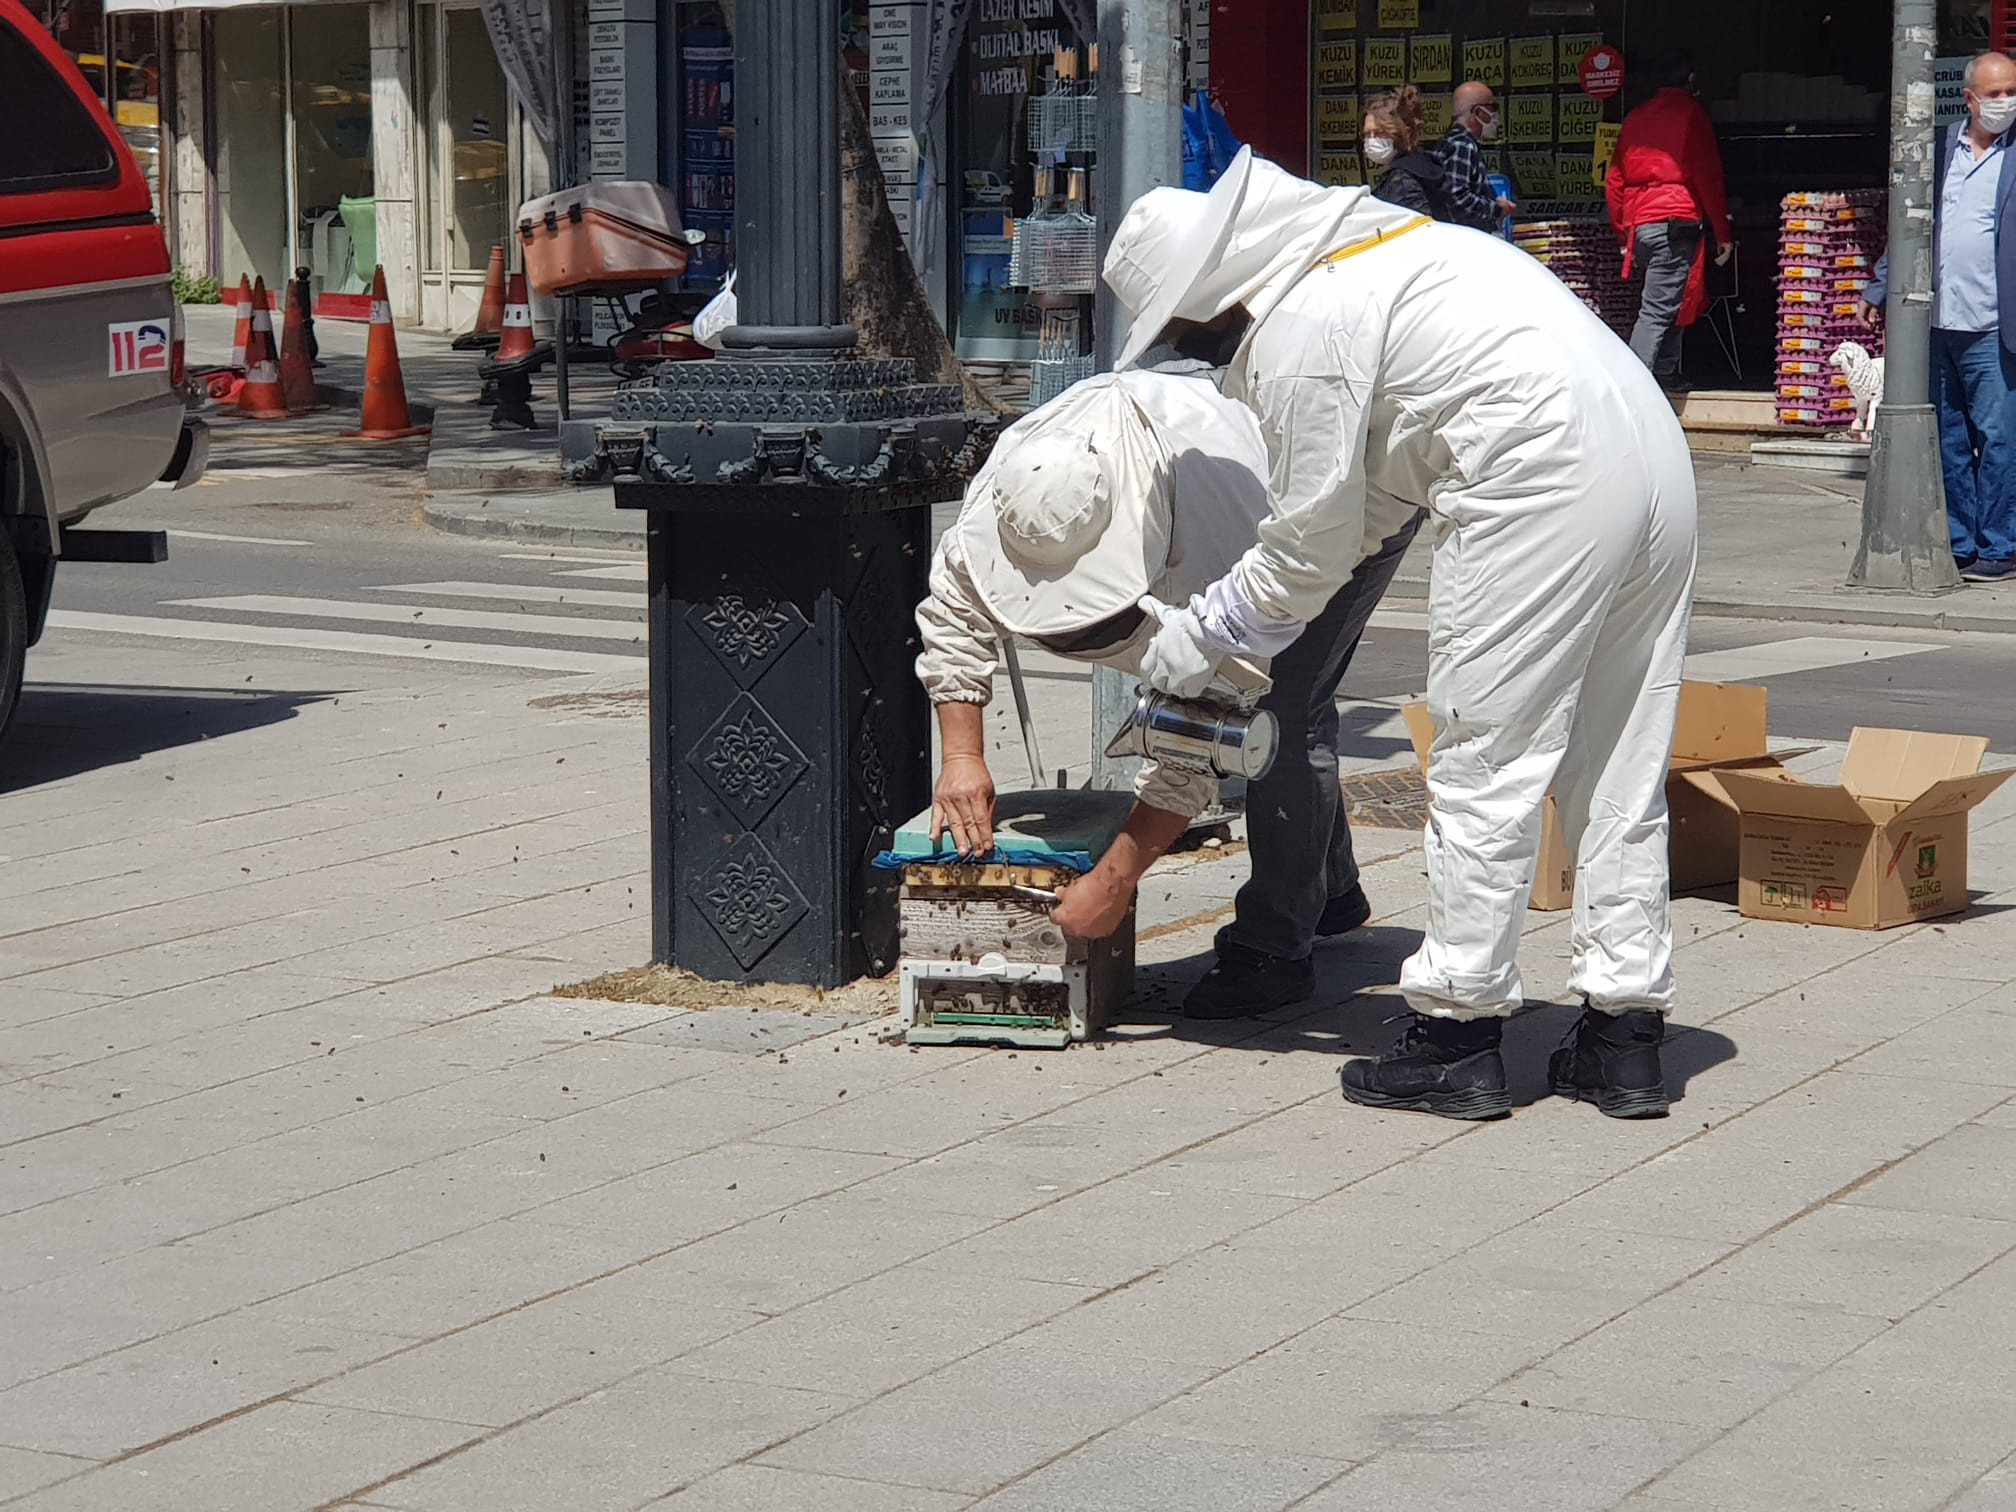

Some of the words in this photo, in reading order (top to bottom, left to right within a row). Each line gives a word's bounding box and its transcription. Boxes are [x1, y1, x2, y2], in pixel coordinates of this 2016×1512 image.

[1321, 46, 1352, 62] KUZU
[1370, 46, 1399, 60] KUZU
[1465, 44, 1502, 61] KUZU
[1520, 45, 1542, 58] KUZU
[1319, 65, 1354, 84] KEMİK
[1366, 63, 1403, 79] YÜREK
[879, 76, 900, 86] CEPHE
[980, 68, 1028, 95] MATBAA
[875, 89, 905, 98] KAPLAMA
[1326, 101, 1348, 114] DANA
[1518, 100, 1543, 115] KUZU
[1564, 101, 1600, 115] KUZU
[873, 117, 887, 126] BAS
[893, 115, 907, 125] KES
[1320, 157, 1358, 171] DANA
[1561, 161, 1592, 175] DANA
[112, 325, 166, 372] 112
[1909, 880, 1941, 899] zaika
